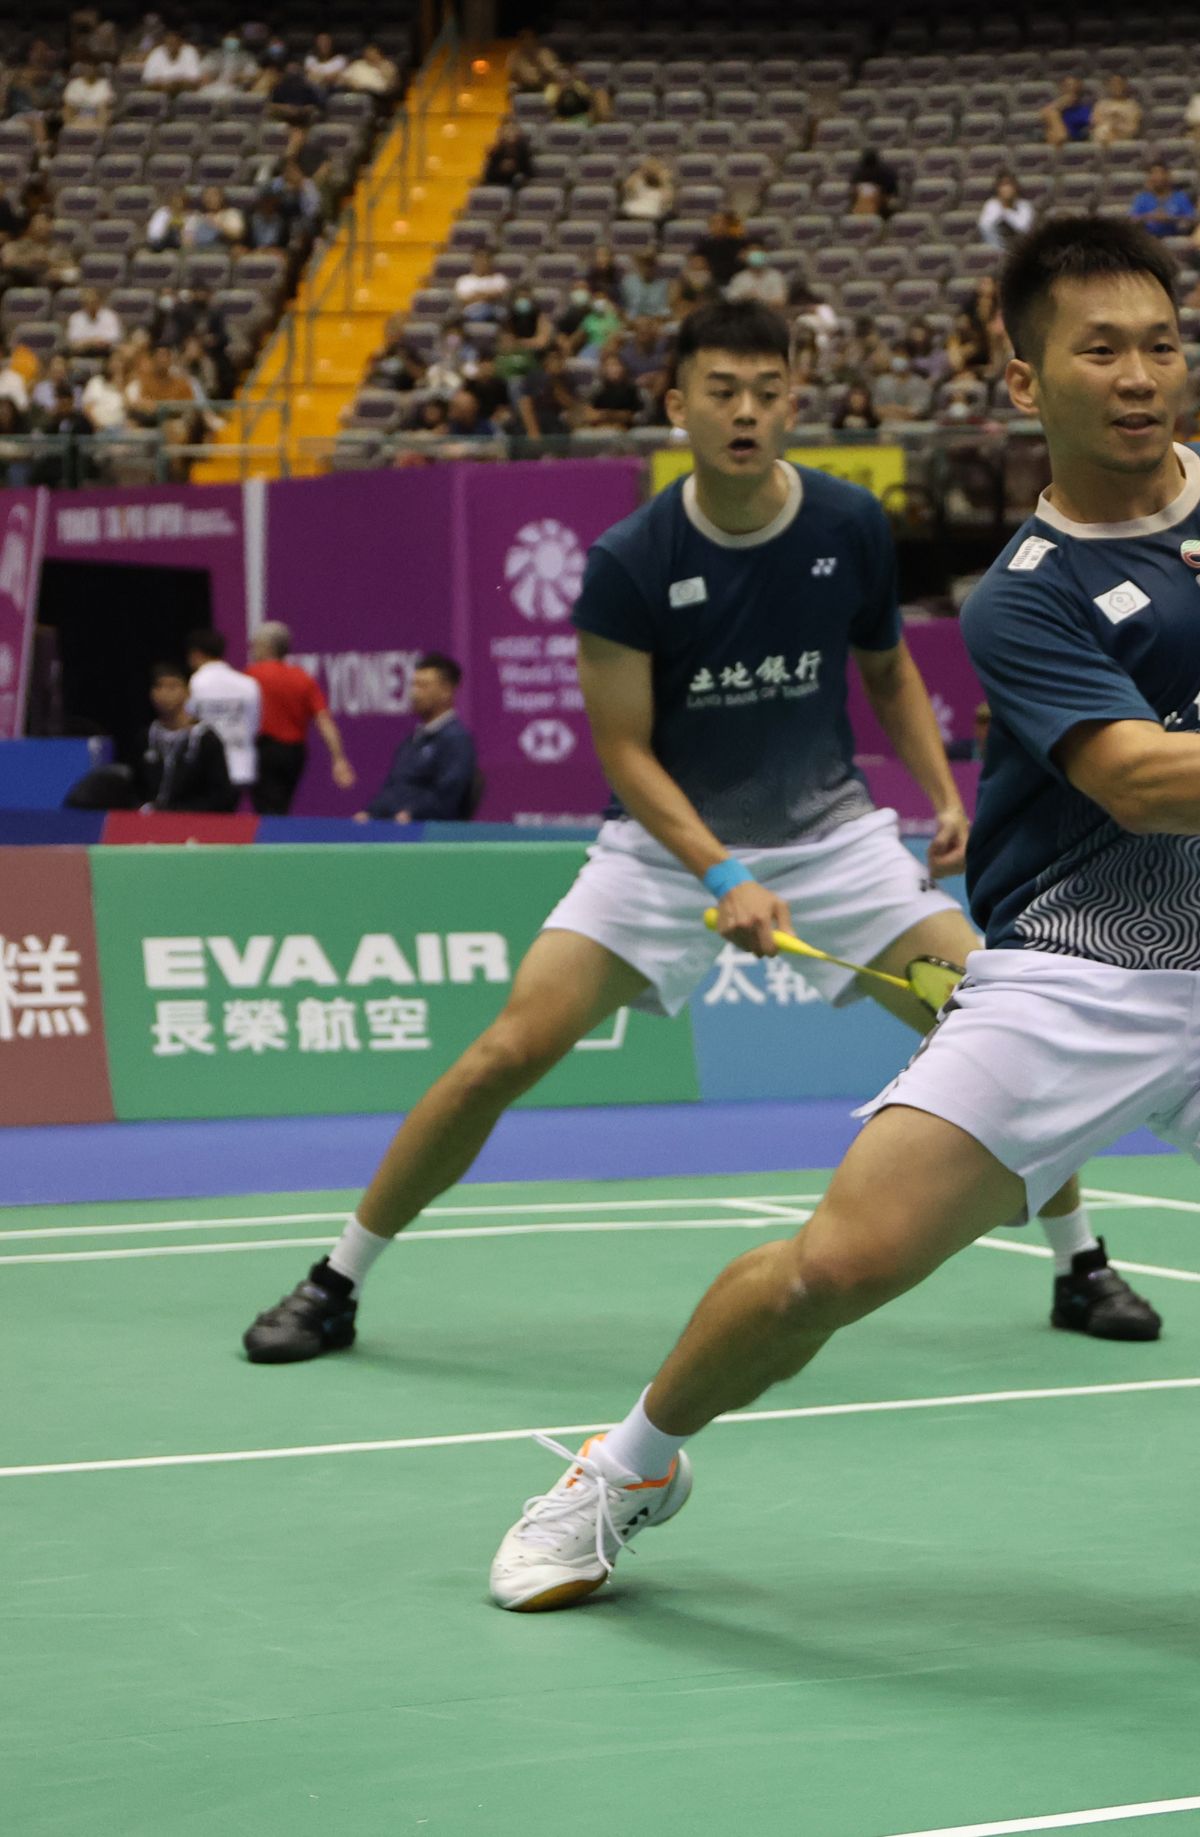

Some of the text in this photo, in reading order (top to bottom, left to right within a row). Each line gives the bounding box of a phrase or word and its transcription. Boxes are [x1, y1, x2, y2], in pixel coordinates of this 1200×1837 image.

[689, 650, 821, 692] 土地銀行
[142, 931, 512, 989] EVA AIR
[150, 997, 433, 1056] 長榮航空
